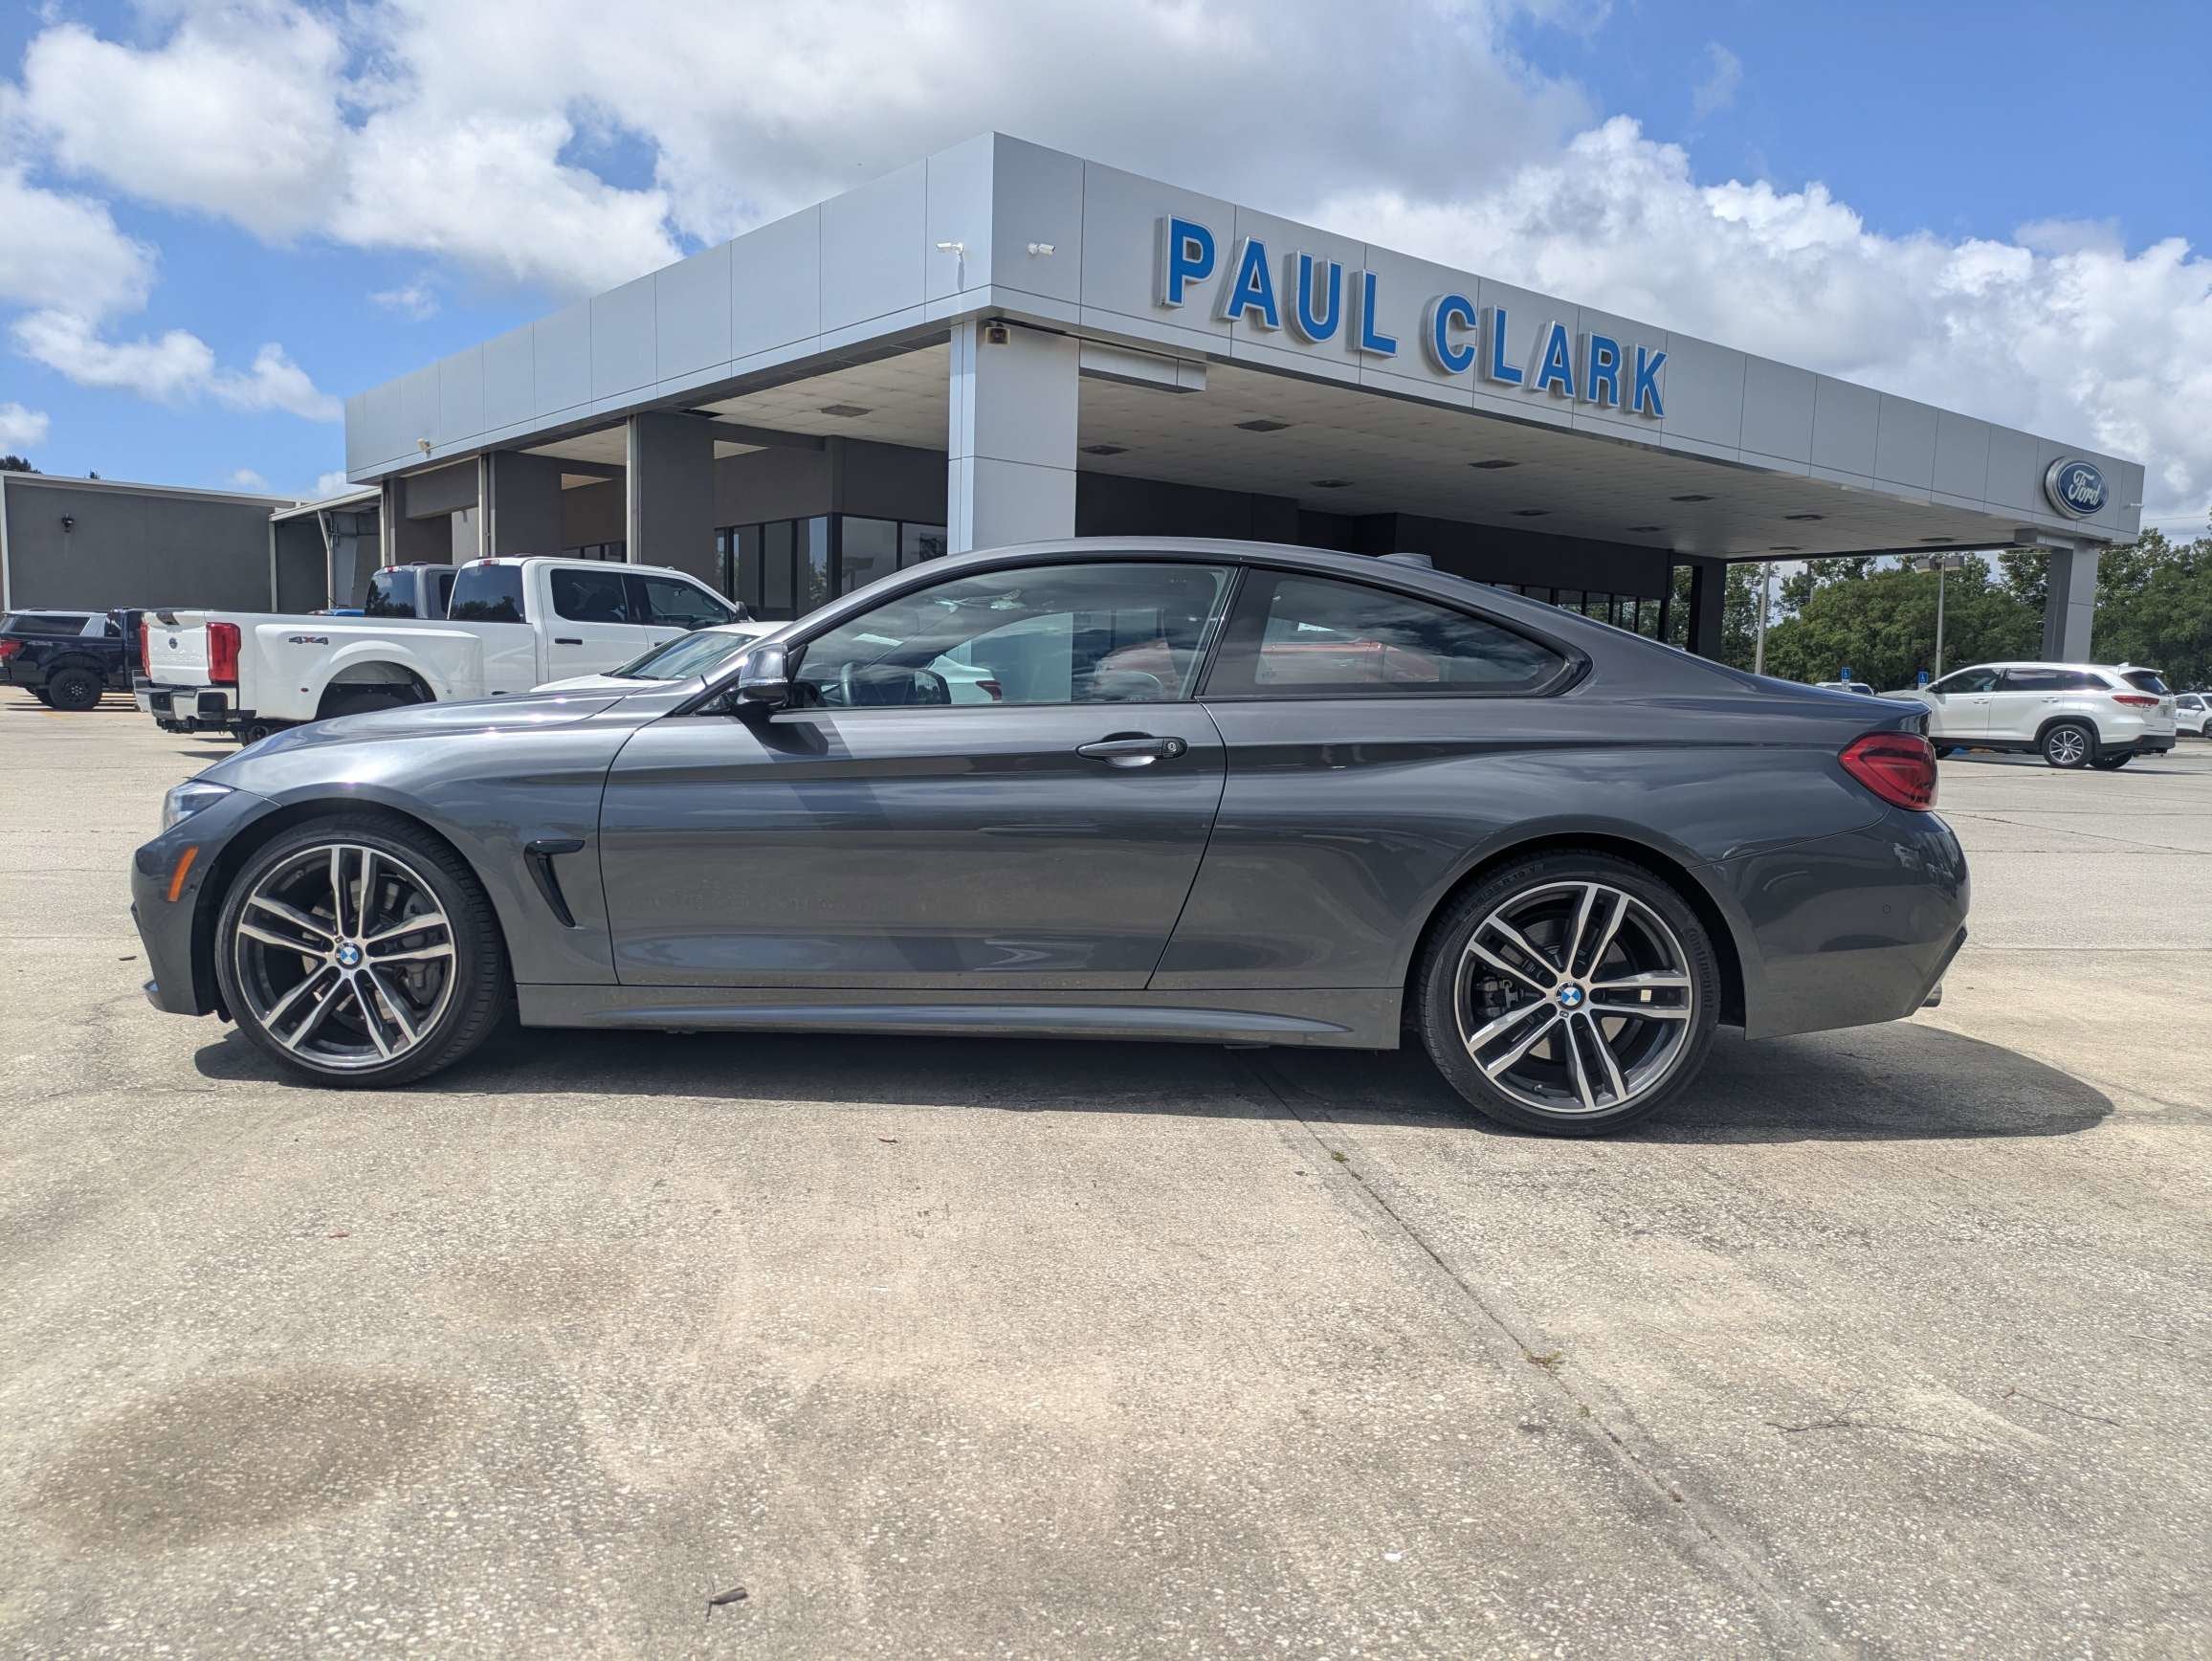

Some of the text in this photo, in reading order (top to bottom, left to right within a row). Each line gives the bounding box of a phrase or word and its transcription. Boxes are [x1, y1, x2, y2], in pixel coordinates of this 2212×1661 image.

[1161, 213, 1669, 418] PAUL CLARK
[2068, 469, 2102, 506] Ford
